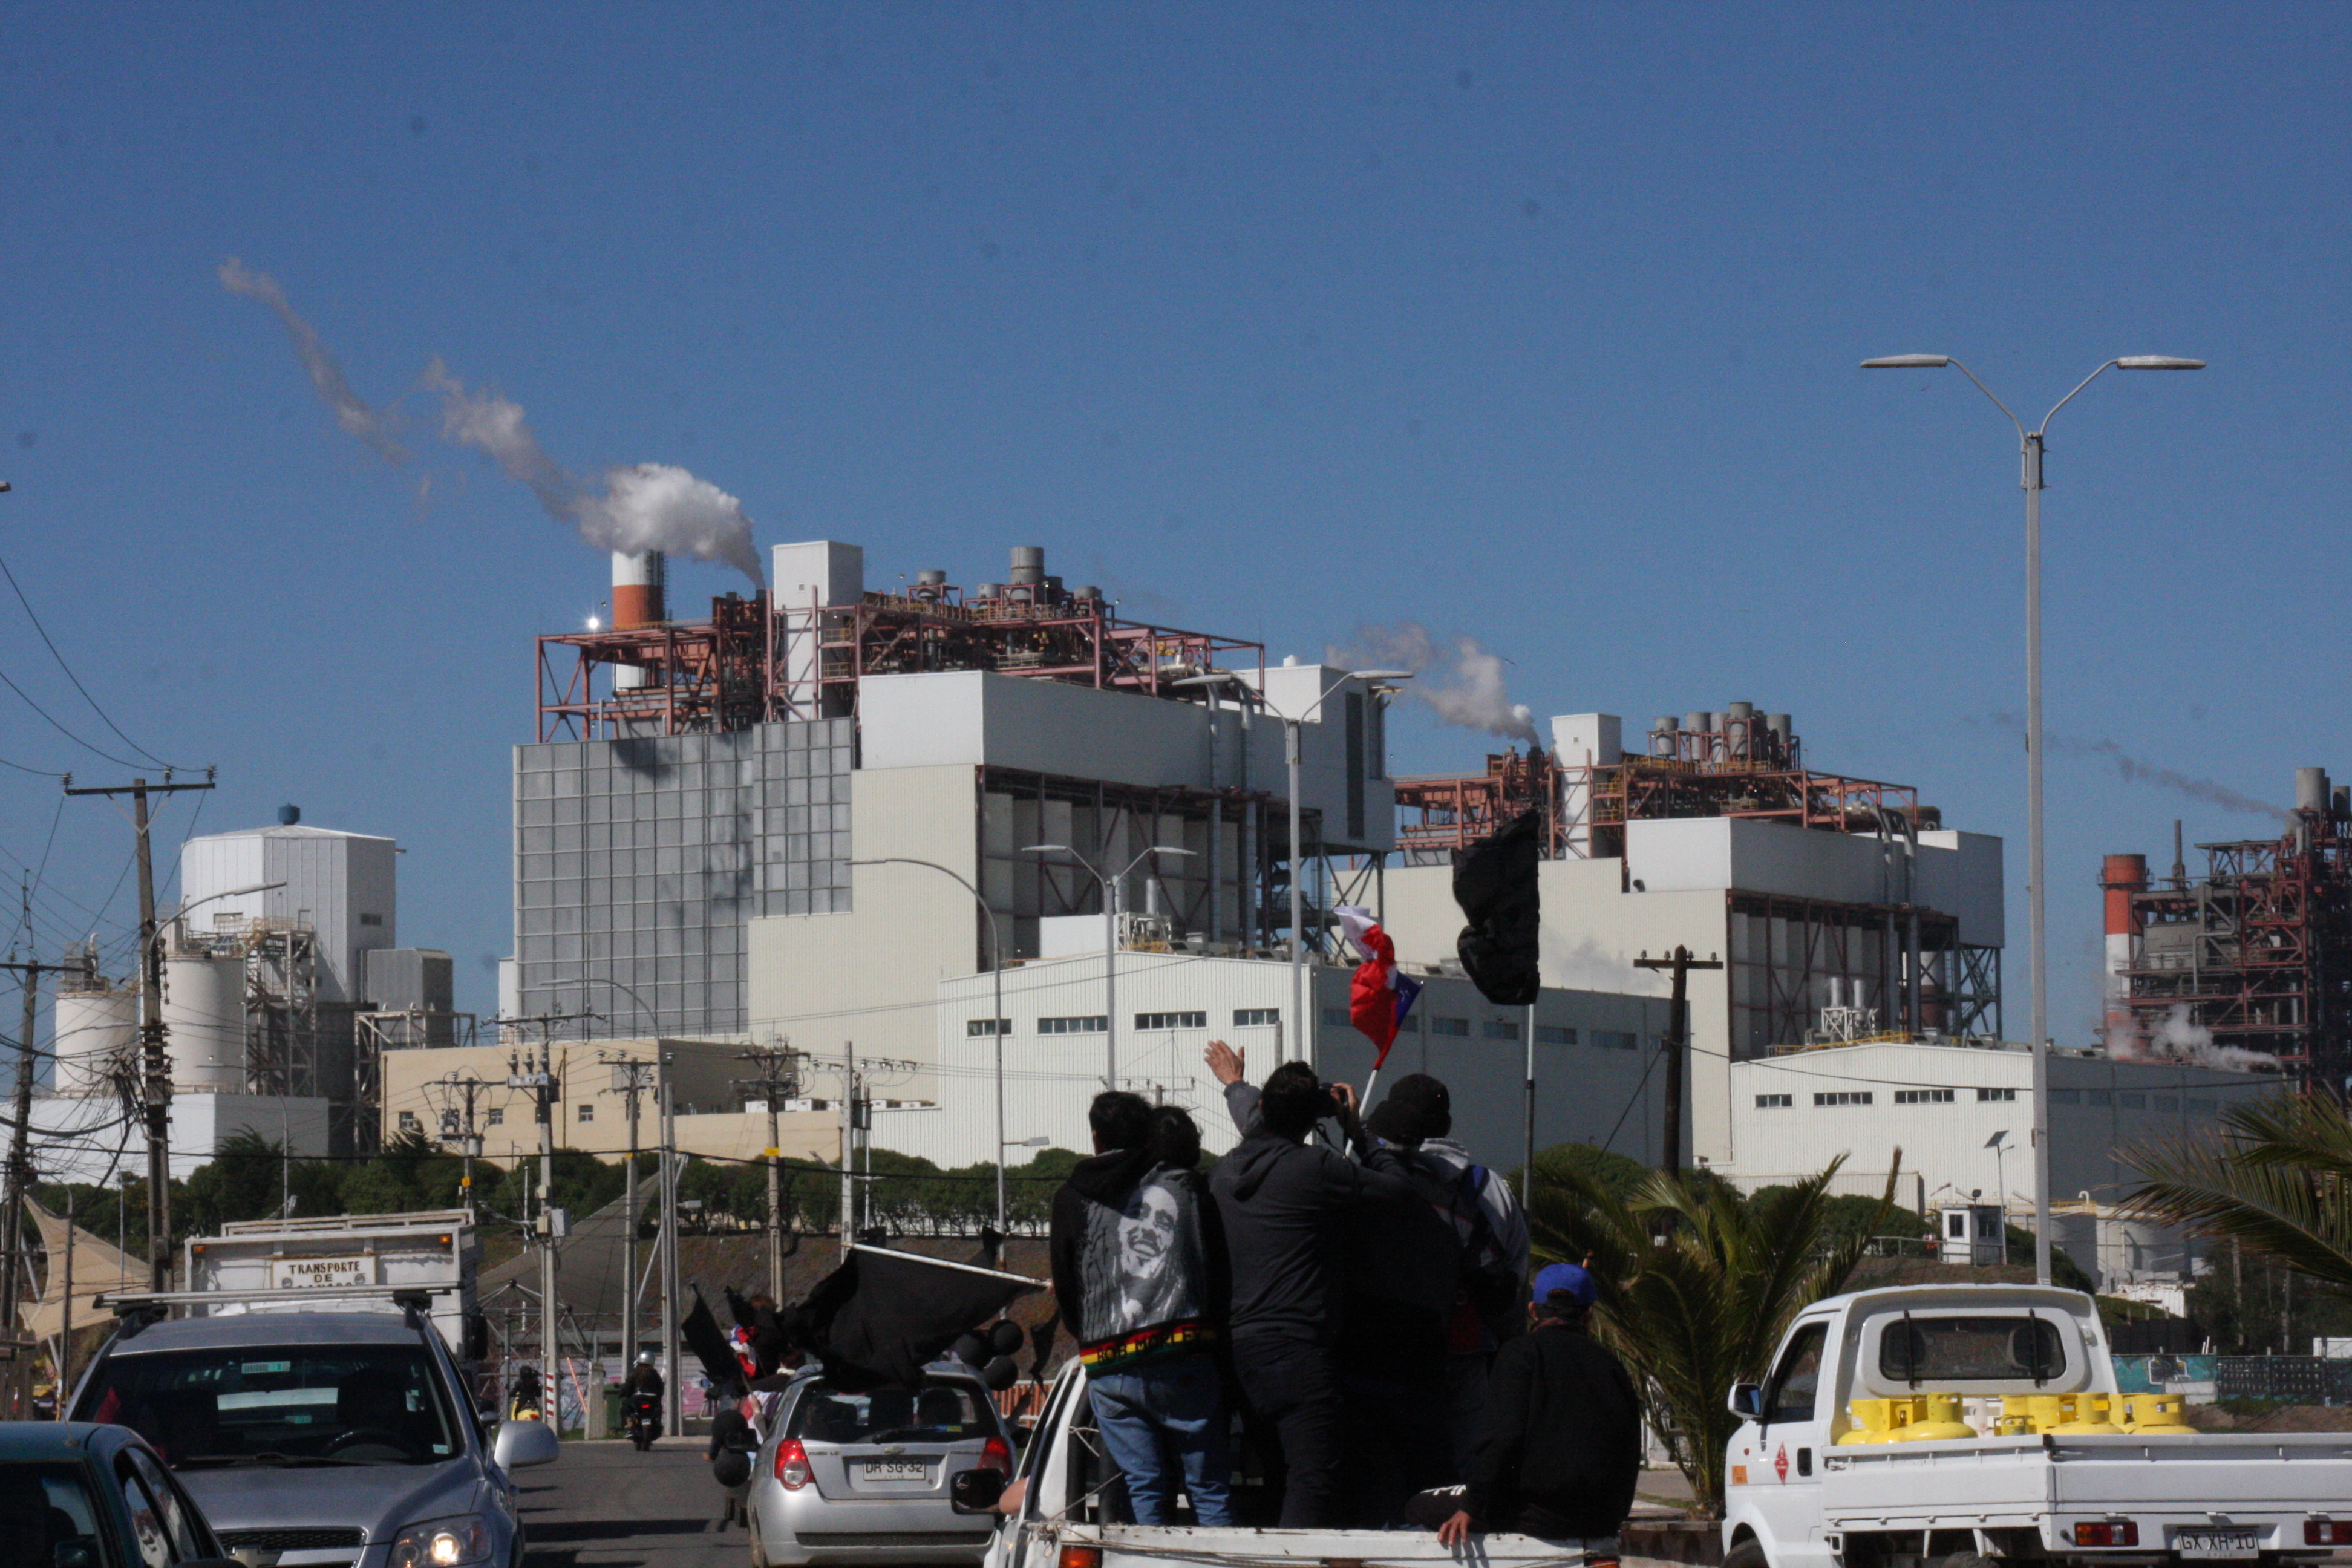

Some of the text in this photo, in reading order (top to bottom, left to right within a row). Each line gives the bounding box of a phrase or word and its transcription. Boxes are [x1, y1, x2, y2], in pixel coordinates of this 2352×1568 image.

[289, 1261, 361, 1275] TRANSPORTE
[315, 1274, 332, 1283] DE
[2207, 1533, 2229, 1550] XH
